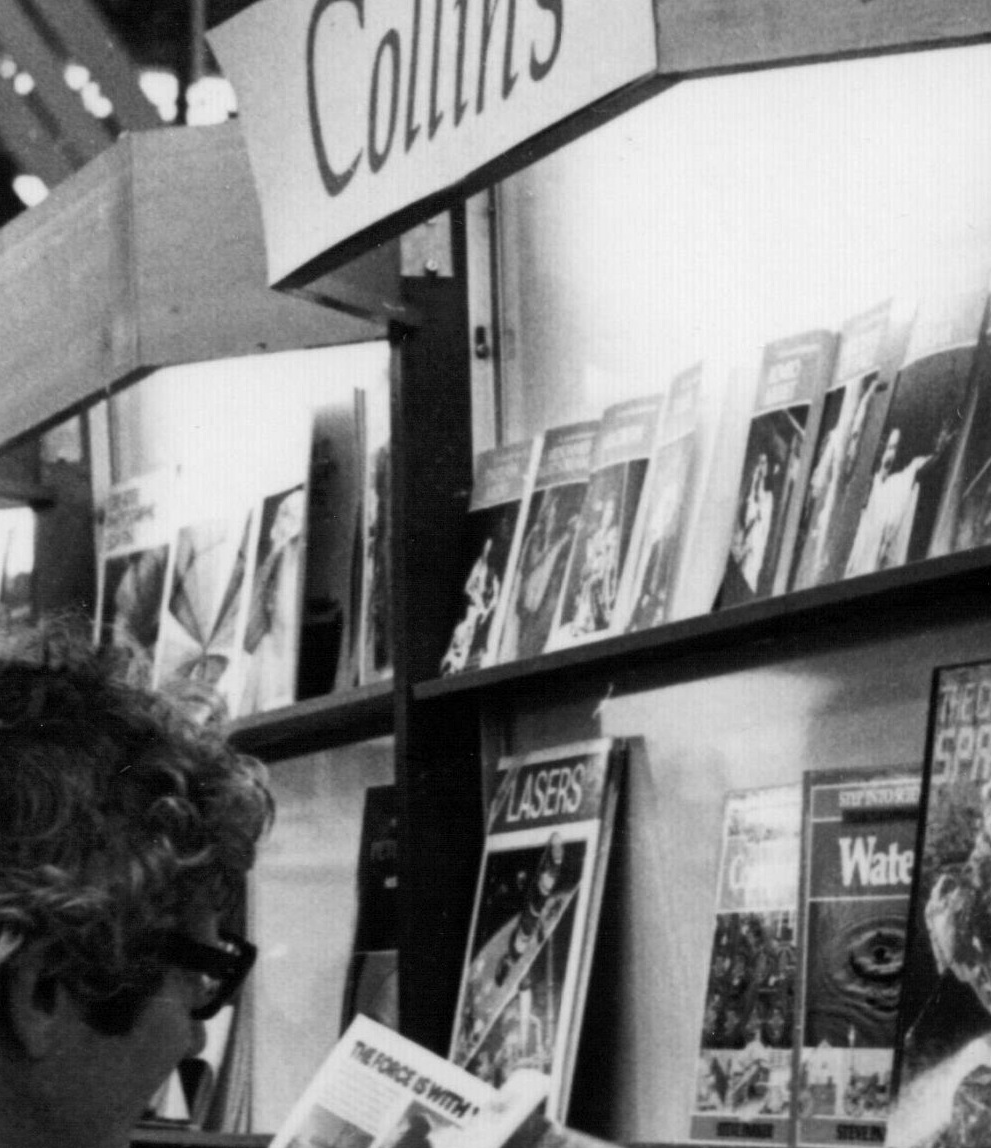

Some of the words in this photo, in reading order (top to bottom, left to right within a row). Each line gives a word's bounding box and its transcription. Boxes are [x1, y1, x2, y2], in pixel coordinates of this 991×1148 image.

[306, 0, 565, 198] Collins
[506, 762, 586, 823] LASERS
[839, 836, 915, 887] Wate
[352, 1040, 378, 1067] THE
[372, 1052, 417, 1087] FORCE
[412, 1076, 431, 1095] IS
[427, 1082, 472, 1119] WITH
